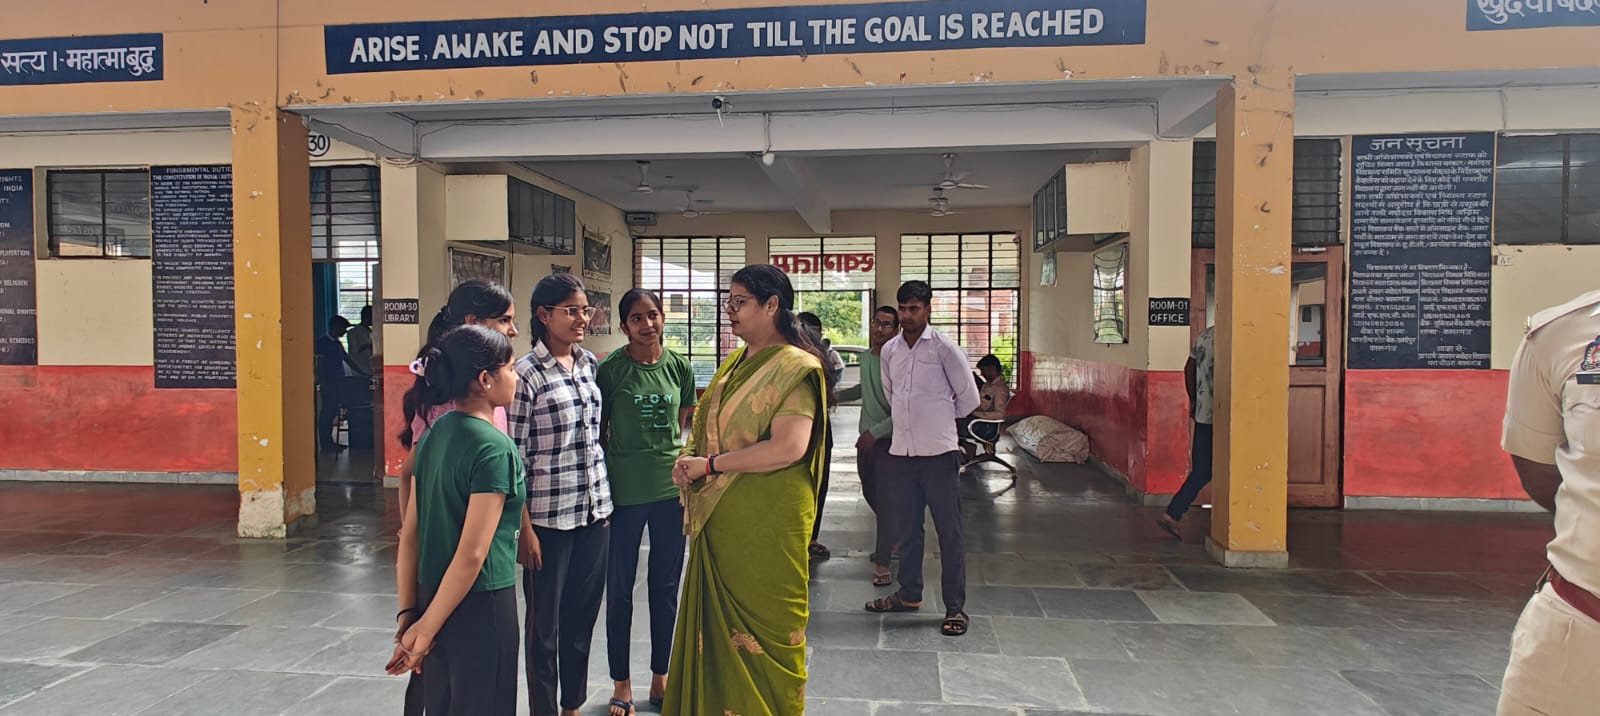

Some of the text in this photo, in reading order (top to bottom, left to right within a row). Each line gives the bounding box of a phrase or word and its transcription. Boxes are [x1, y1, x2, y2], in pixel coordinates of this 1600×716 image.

[432, 30, 523, 60] AWAKE
[532, 28, 594, 56] AND
[603, 25, 673, 53] STOP
[679, 23, 734, 50] NOT
[747, 20, 803, 48] TILL
[808, 18, 857, 45] THE
[864, 15, 932, 44] GOAL
[939, 13, 965, 40] IS
[972, 8, 1105, 39] REACHED
[1, 51, 48, 74] सत्य
[307, 135, 326, 151] 30
[1369, 136, 1467, 152] जन सूचना
[384, 302, 418, 311] ROOM-30
[1150, 301, 1188, 310] ROOM-01
[384, 313, 416, 322] LIBRARY
[1150, 313, 1185, 323] OFFICE
[634, 393, 673, 404] PROXY
